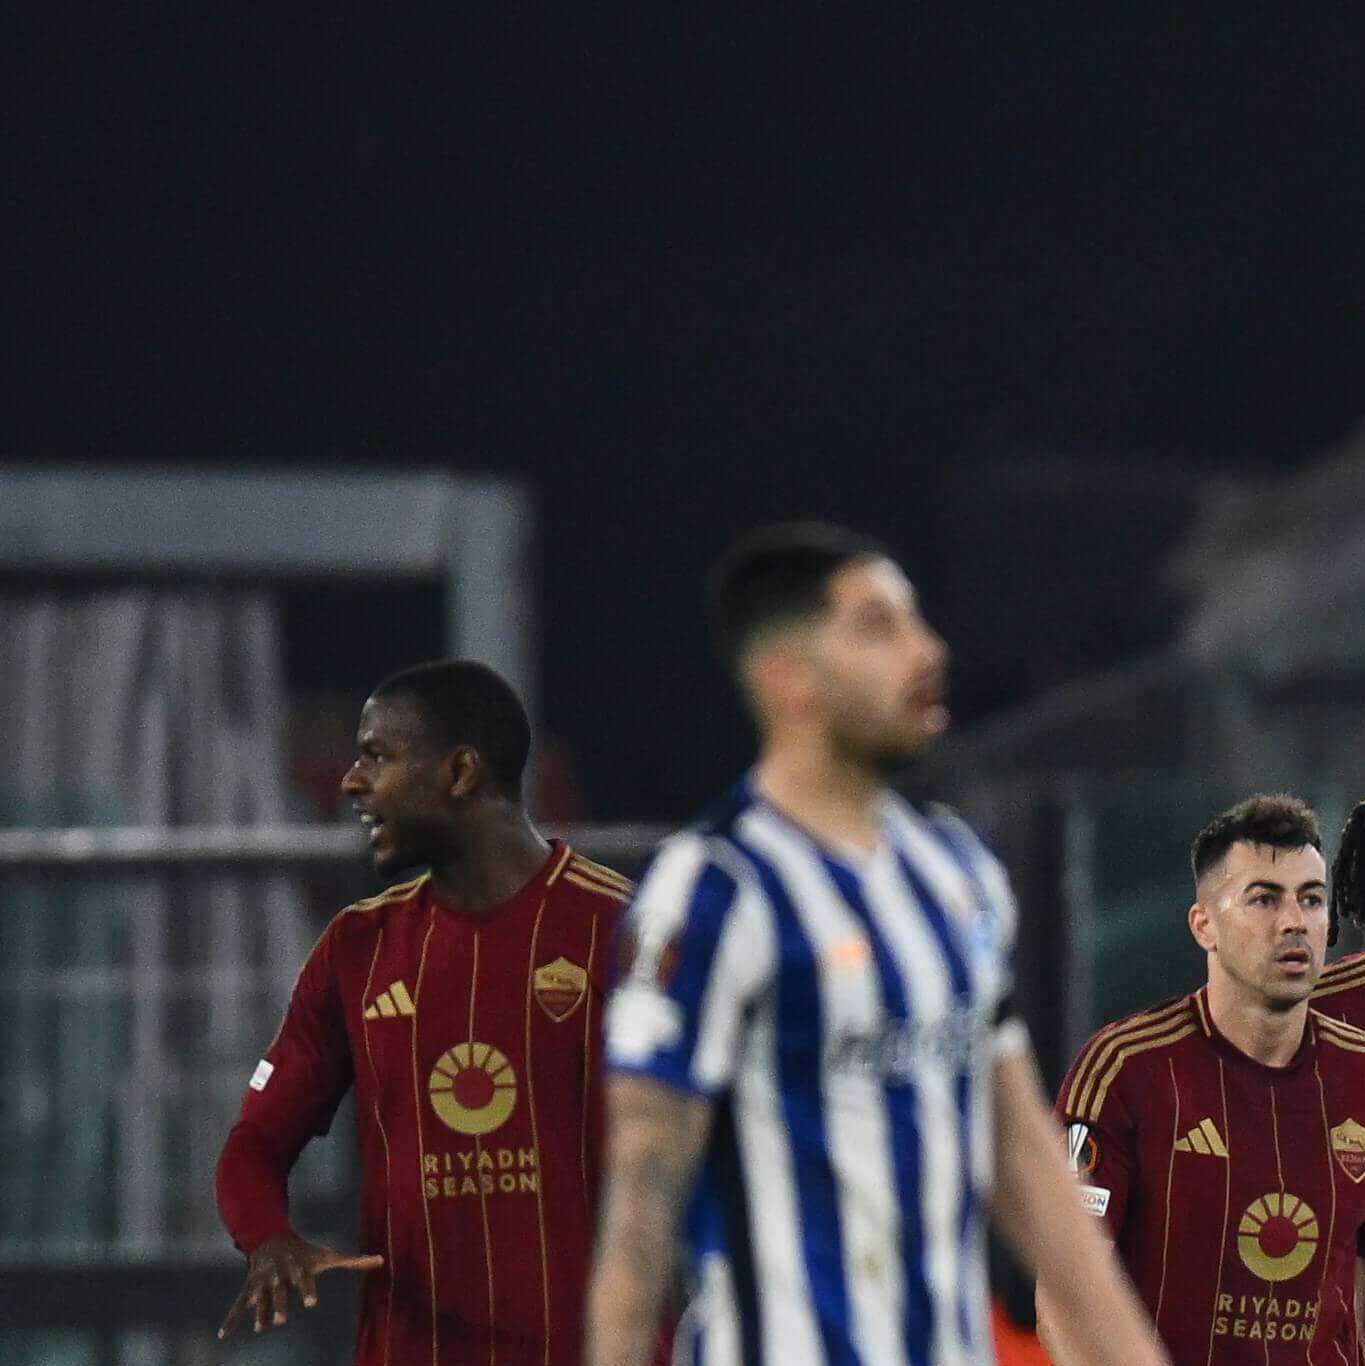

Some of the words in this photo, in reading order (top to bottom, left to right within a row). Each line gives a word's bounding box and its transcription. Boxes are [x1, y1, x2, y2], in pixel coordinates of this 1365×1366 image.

[423, 1148, 538, 1174] RIYADH
[425, 1172, 538, 1199] SEASON
[1218, 1293, 1319, 1319] RIYADH
[1215, 1316, 1316, 1341] SEASON
